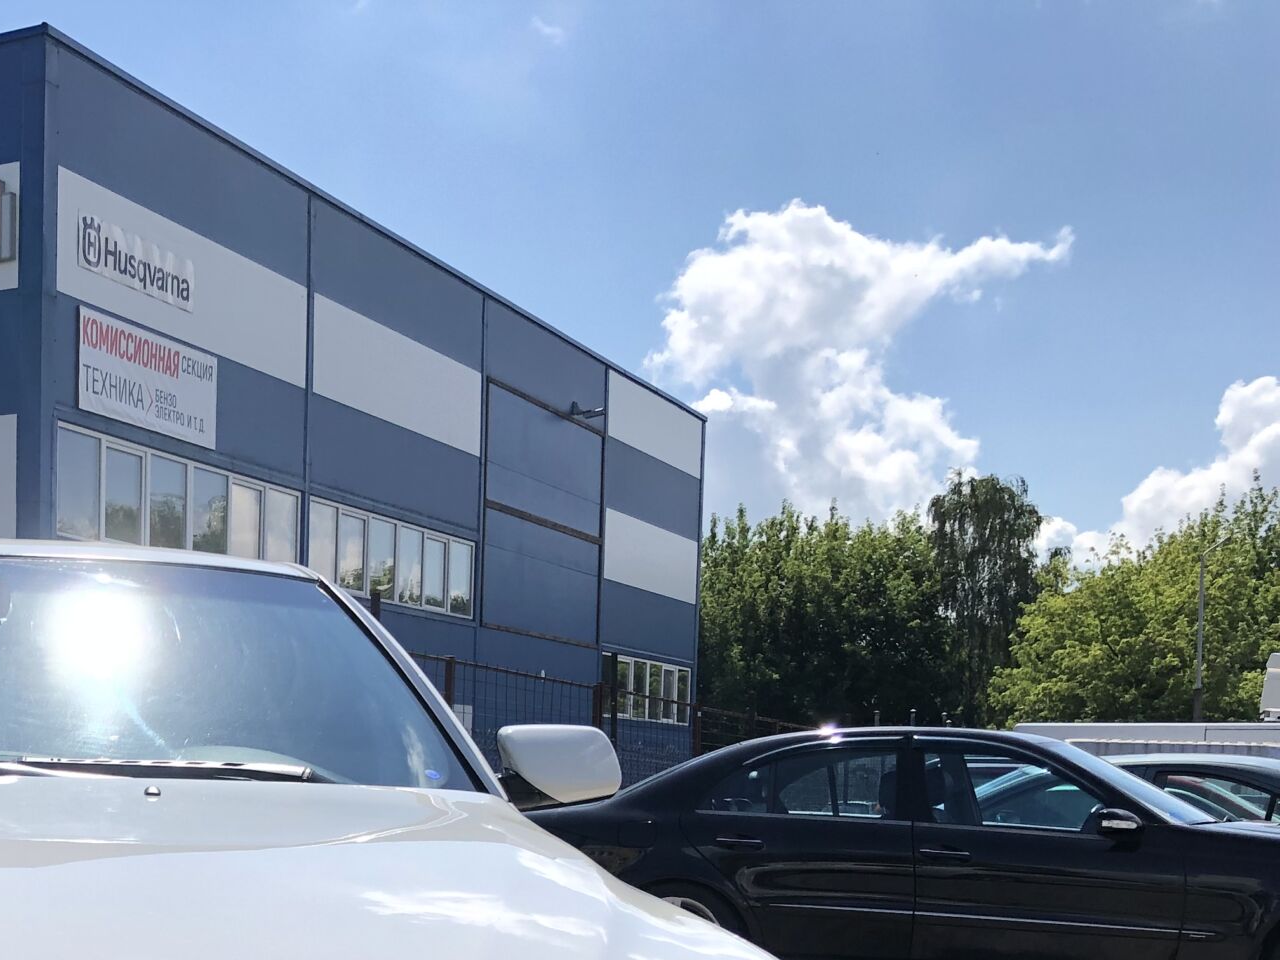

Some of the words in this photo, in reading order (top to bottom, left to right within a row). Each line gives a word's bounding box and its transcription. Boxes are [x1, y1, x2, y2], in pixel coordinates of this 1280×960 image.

[104, 237, 190, 302] Husqvarna
[82, 315, 180, 379] КОМИССИОННАЯ
[181, 355, 213, 382] СЕКЦИЯ
[82, 364, 144, 411] ТЕХНИКА
[155, 389, 177, 409] БЕНЗО
[155, 404, 184, 426] ЭЛЕКТРО
